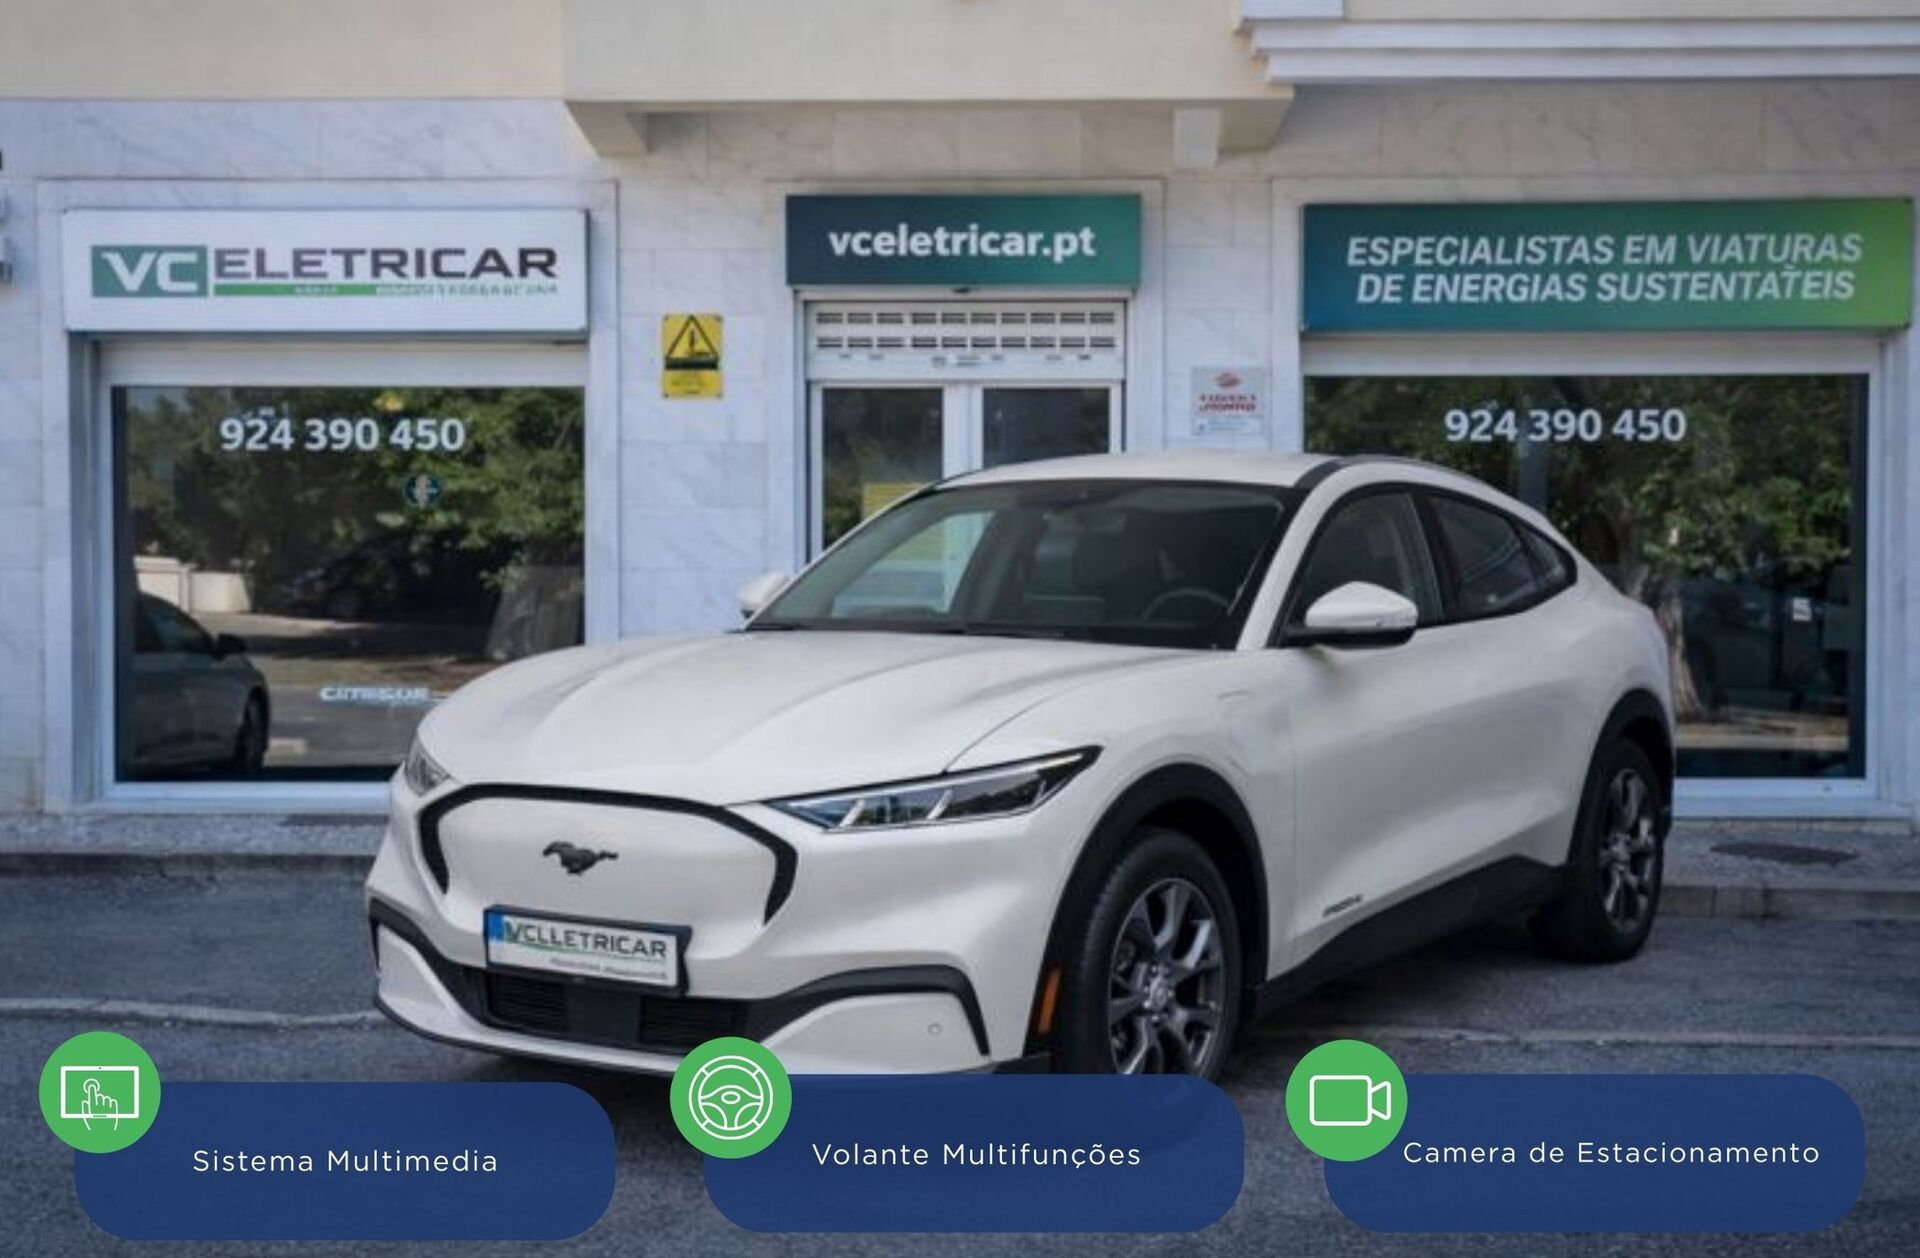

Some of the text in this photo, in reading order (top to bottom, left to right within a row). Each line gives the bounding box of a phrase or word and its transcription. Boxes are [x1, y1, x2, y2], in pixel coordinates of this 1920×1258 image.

[828, 223, 1097, 264] vceletricar.pt
[1346, 233, 1864, 267] ESPECIALISTAS EM VIATURAS
[214, 247, 559, 279] ELETRICAR
[1356, 273, 1404, 304] DE
[1411, 273, 1588, 304] ENERGIAS
[220, 417, 466, 451] 924 390 450
[1444, 408, 1687, 442] 924 390 450
